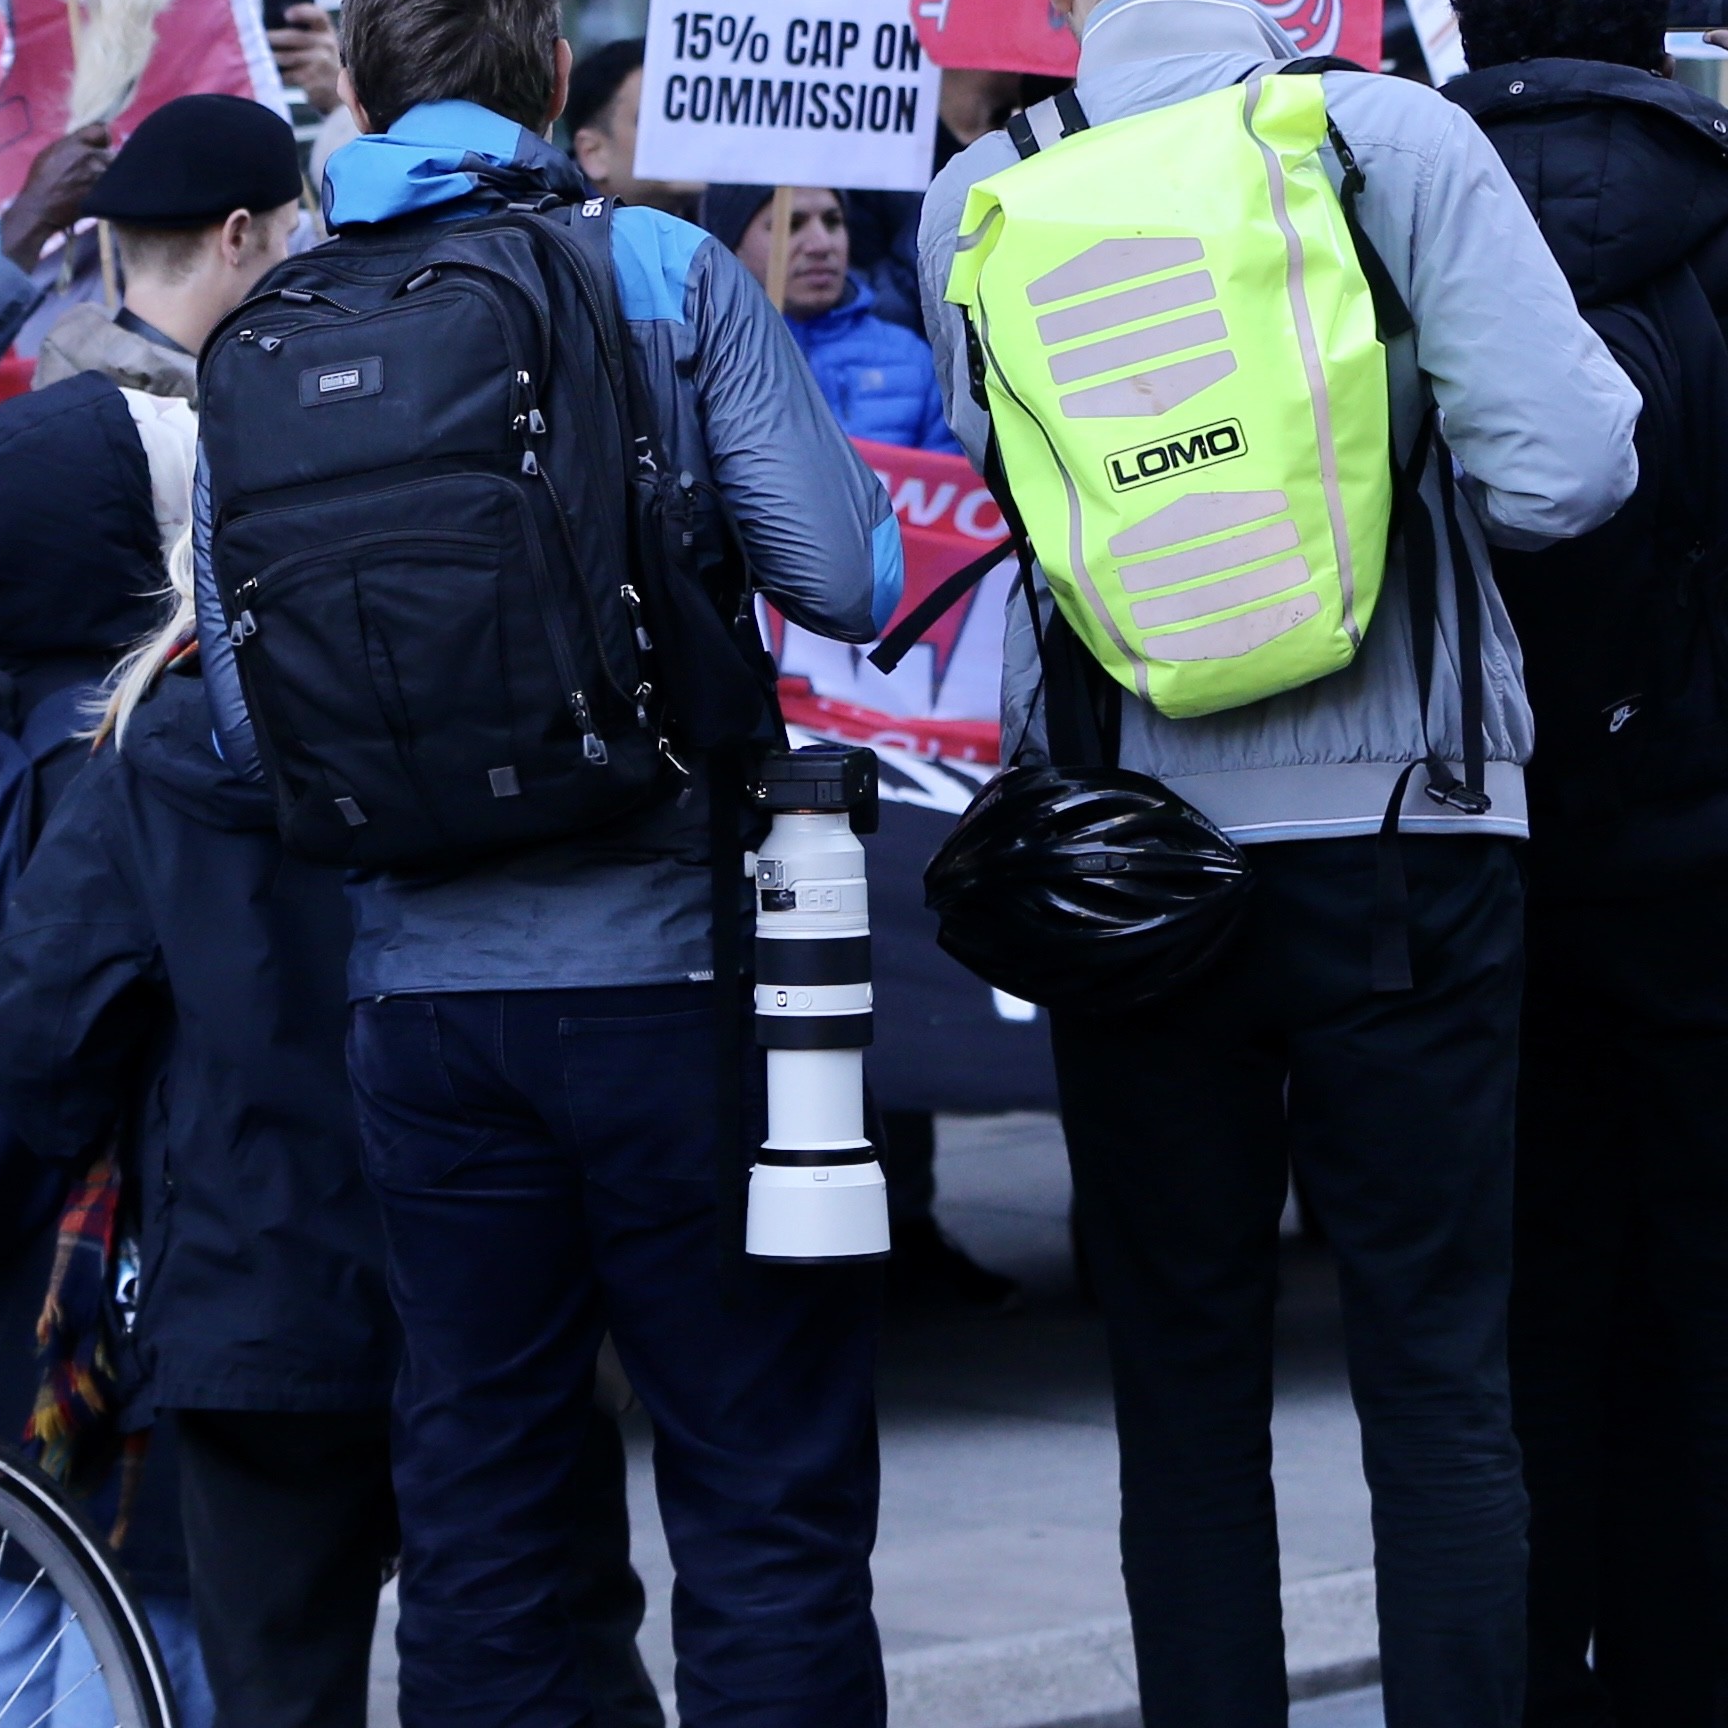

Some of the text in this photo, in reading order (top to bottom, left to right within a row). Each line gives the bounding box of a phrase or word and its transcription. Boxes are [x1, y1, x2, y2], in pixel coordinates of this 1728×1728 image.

[672, 13, 921, 72] 15% CAP ON
[663, 75, 918, 133] COMMISSION
[1111, 426, 1241, 487] LOMO
